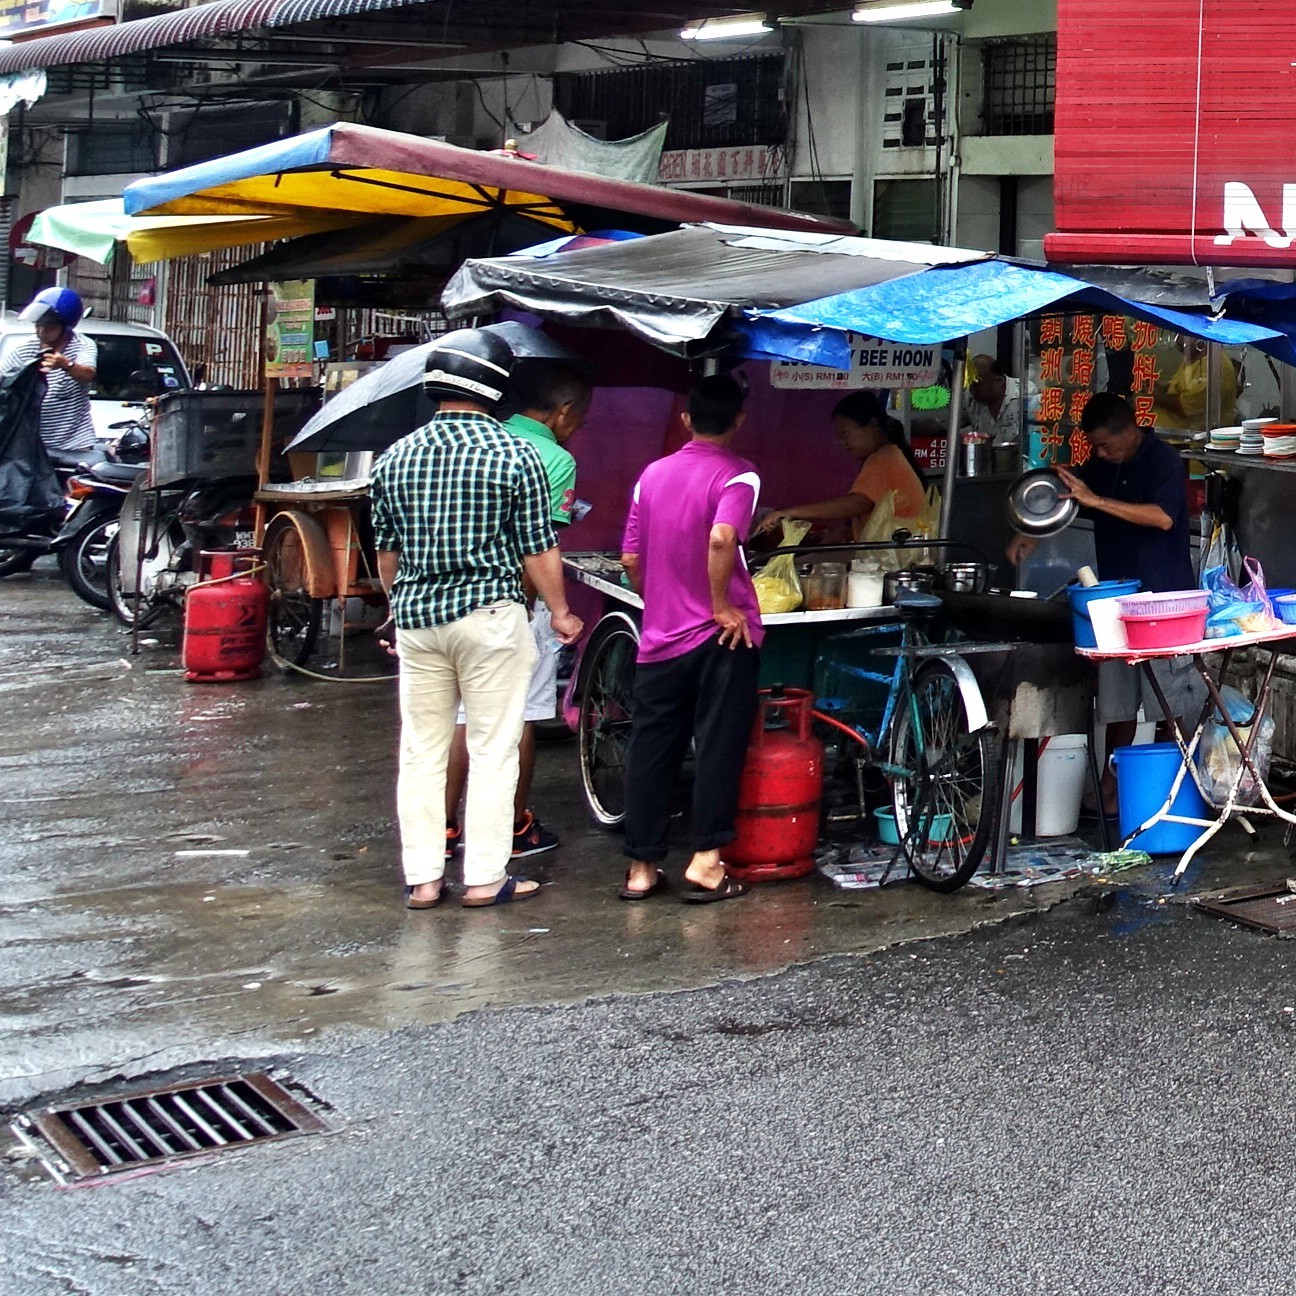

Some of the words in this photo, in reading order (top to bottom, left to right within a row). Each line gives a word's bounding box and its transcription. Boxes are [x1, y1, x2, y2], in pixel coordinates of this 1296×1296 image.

[145, 343, 163, 355] P
[859, 349, 888, 367] BEE
[892, 349, 934, 367] HOON
[914, 449, 928, 458] RM
[561, 489, 575, 512] 2
